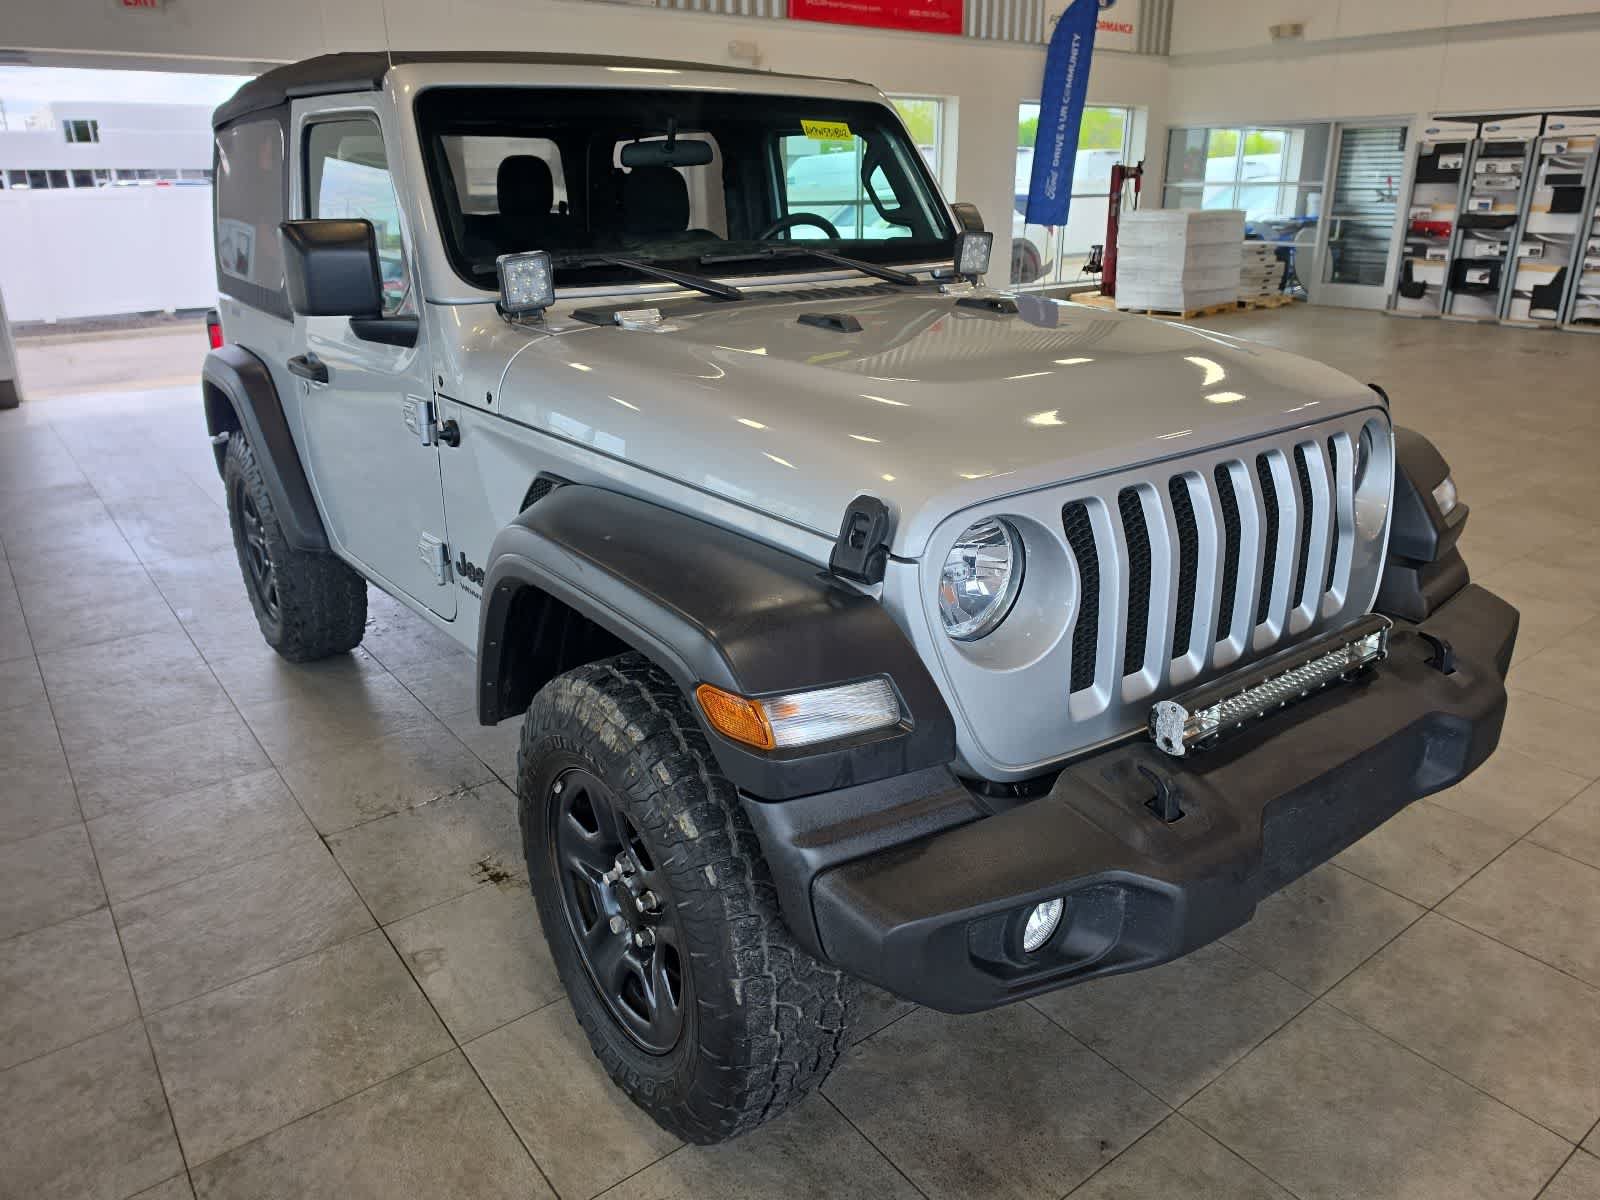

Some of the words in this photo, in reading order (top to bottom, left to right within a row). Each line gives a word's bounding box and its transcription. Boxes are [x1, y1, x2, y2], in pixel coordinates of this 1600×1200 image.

[1096, 20, 1134, 34] ORMANCE
[1052, 133, 1065, 168] DRIVE
[1062, 32, 1082, 104] COMMUNITY
[455, 551, 486, 587] Jee
